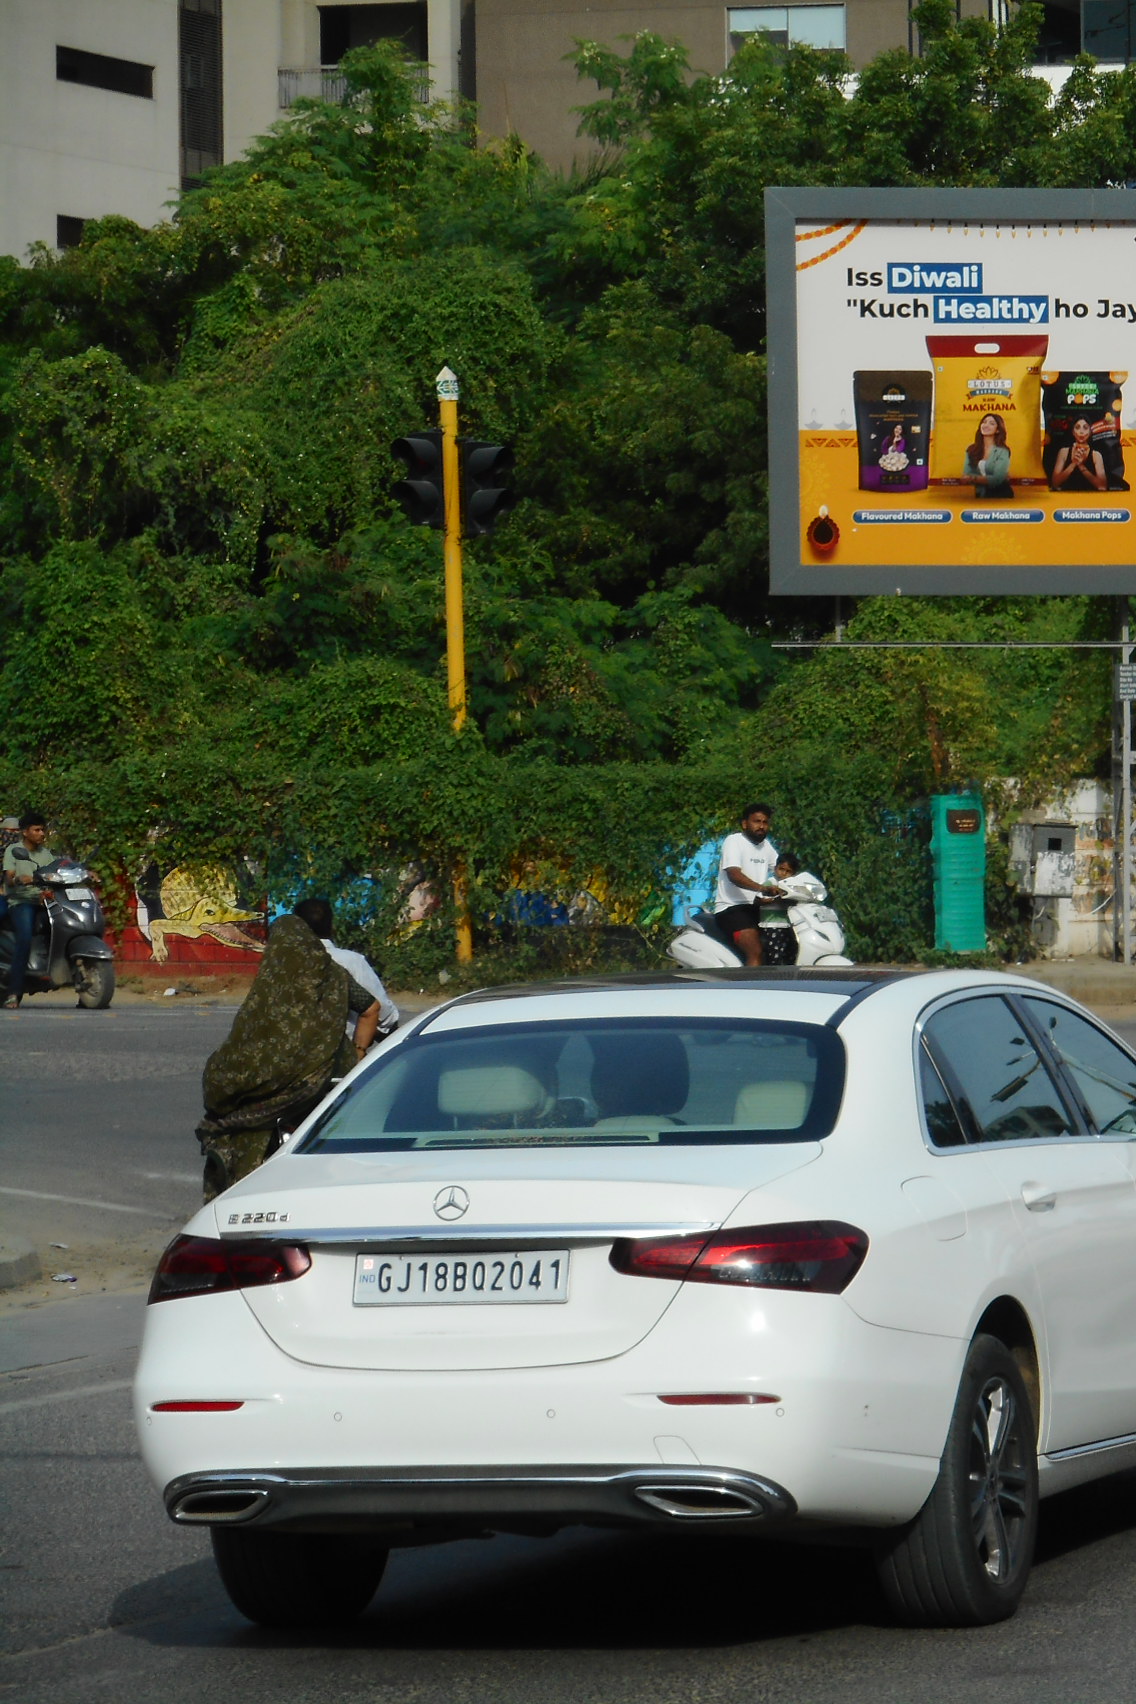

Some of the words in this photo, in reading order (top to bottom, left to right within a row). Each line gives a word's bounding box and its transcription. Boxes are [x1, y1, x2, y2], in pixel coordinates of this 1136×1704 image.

[847, 266, 884, 288] Iss
[891, 265, 979, 289] Diwali
[847, 298, 930, 319] "Kuch
[937, 297, 1047, 324] Healthy
[1055, 298, 1089, 319] ho
[963, 403, 1017, 412] MAKHANA
[861, 512, 903, 520] Flavoured
[904, 512, 943, 520] Makhana
[972, 512, 991, 520] Raw
[992, 511, 1031, 520] Makhana
[1062, 511, 1101, 519] Makhana
[1101, 511, 1122, 521] Pops
[358, 1274, 376, 1284] IND
[377, 1258, 561, 1293] GJ18BQ2041
